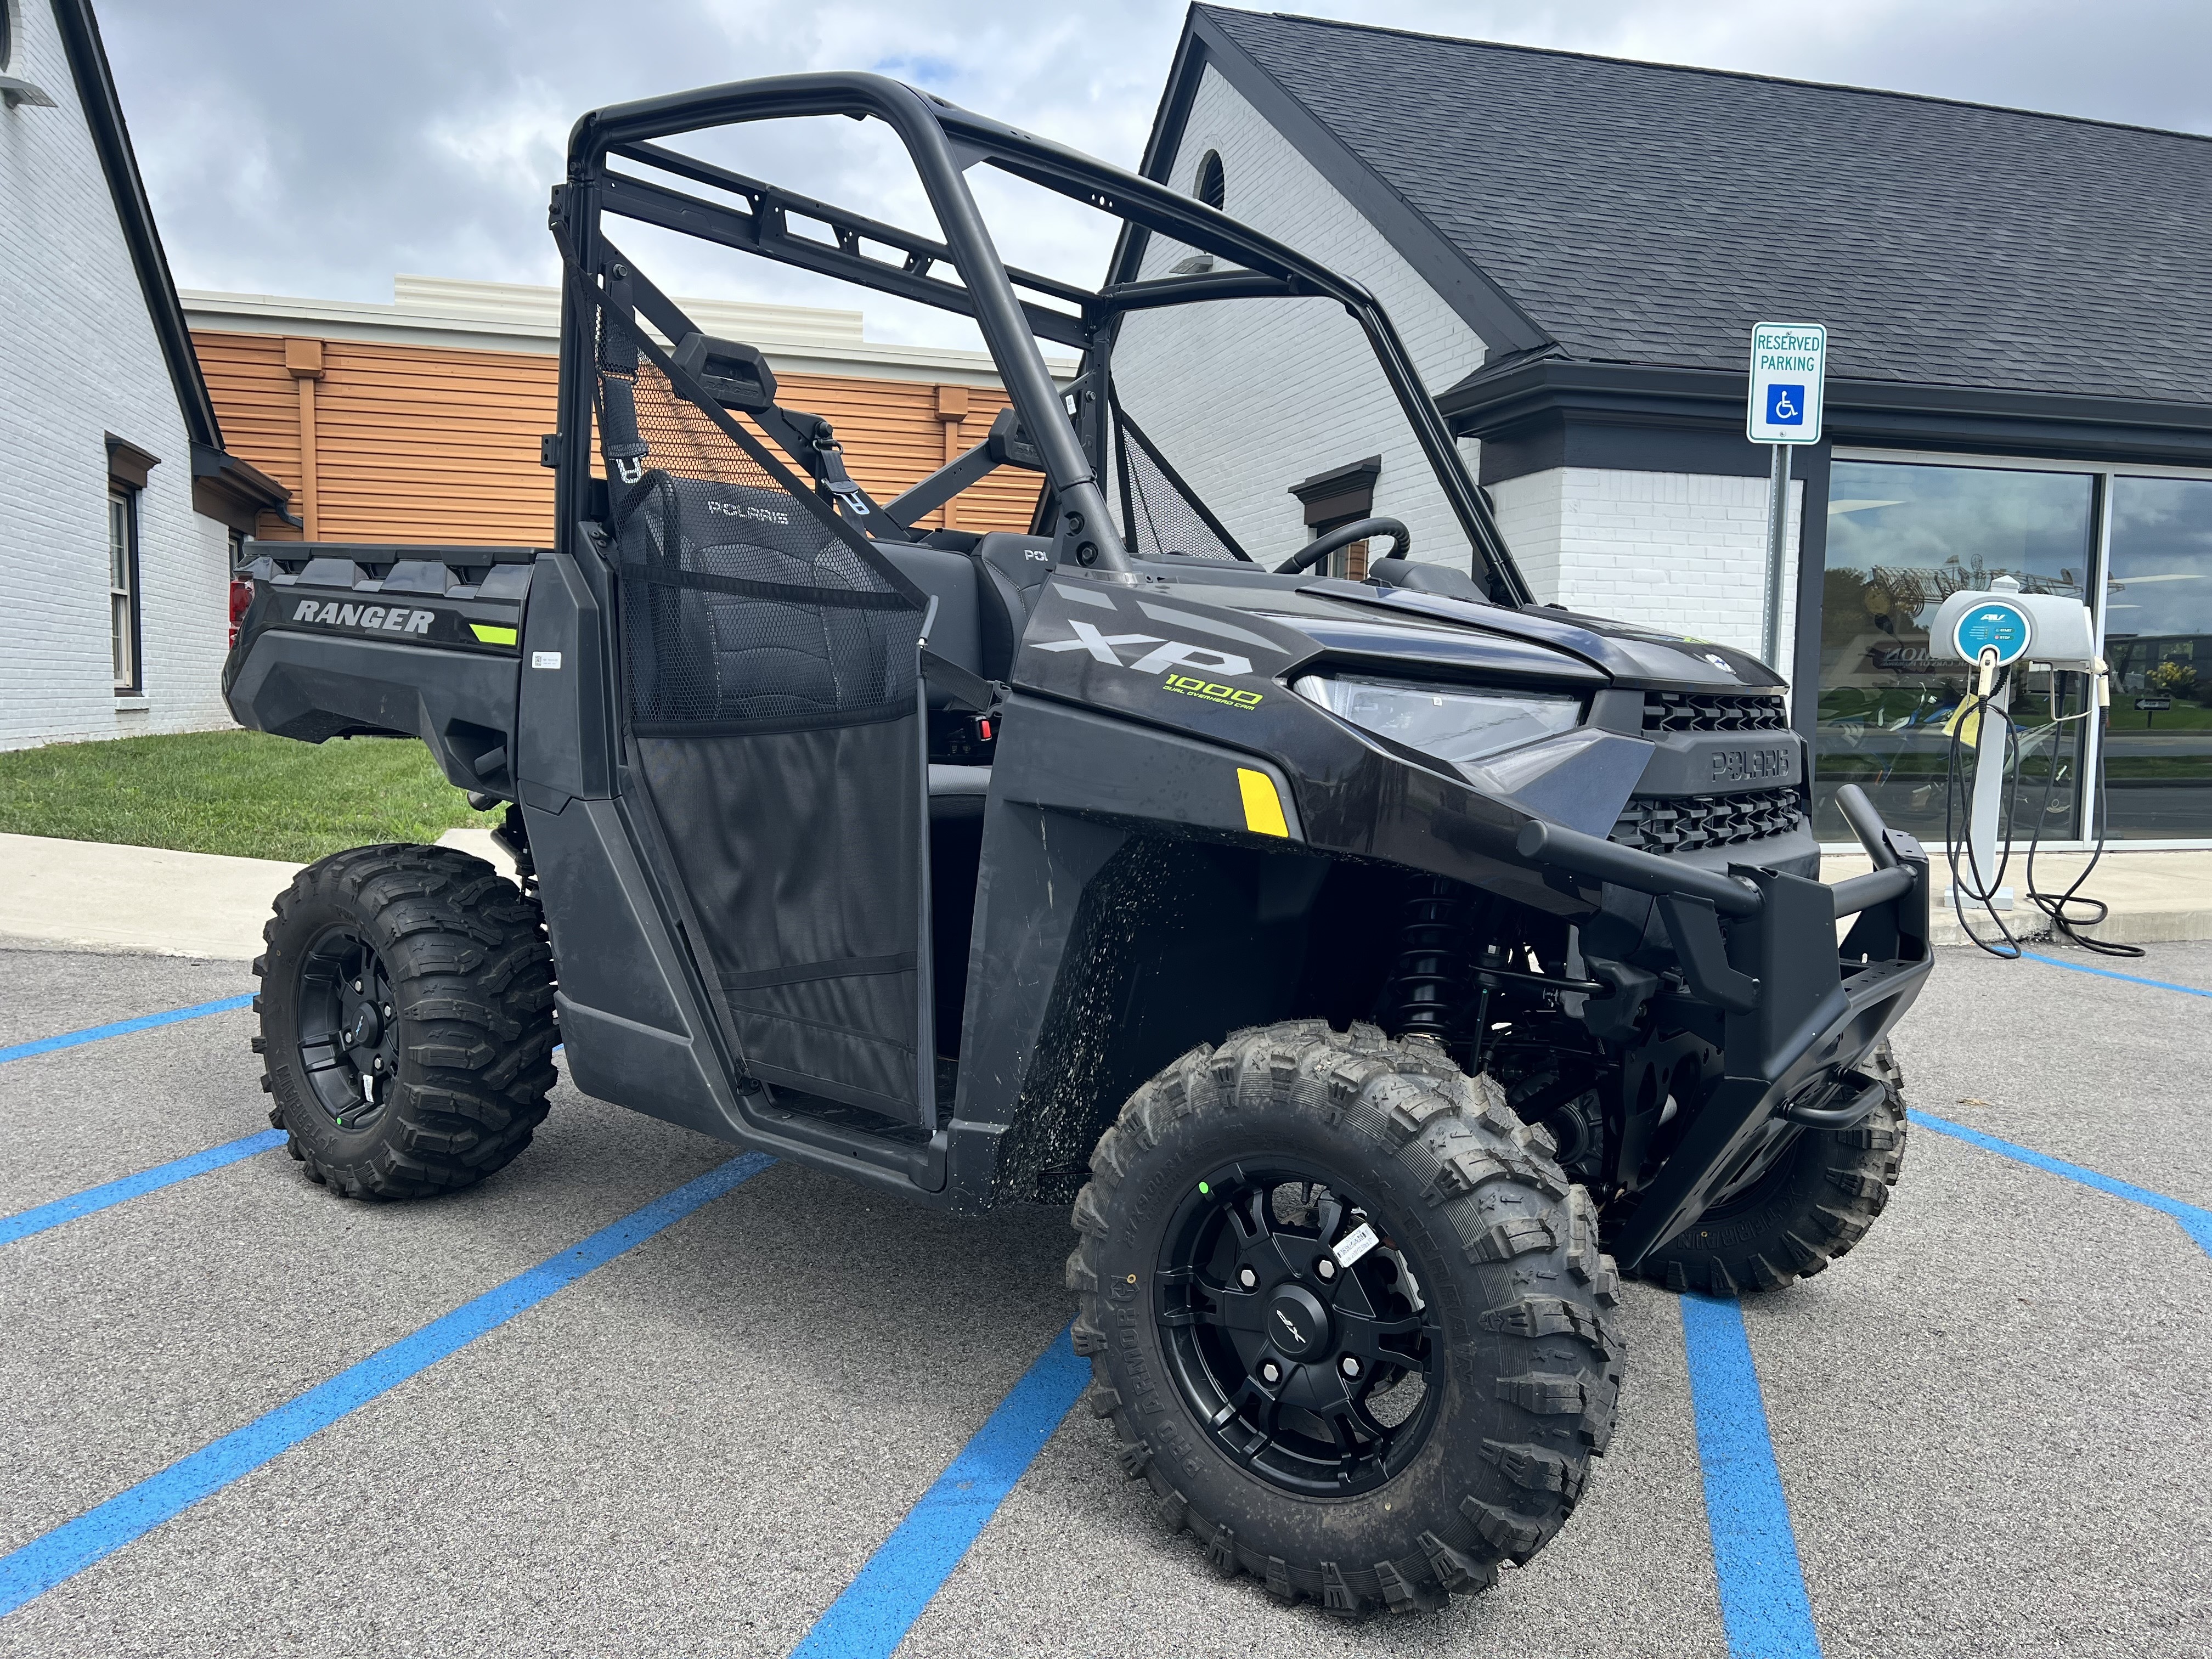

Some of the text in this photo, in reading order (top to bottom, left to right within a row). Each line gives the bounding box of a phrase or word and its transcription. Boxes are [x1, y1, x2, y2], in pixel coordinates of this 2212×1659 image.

[1758, 335, 1820, 351] RESERVED
[1761, 356, 1814, 371] PARKING
[292, 600, 435, 634] RANGER
[1029, 619, 1253, 676] XP
[1162, 685, 1255, 711] DUAL OVERHEAD CAM
[1165, 674, 1263, 705] 1000
[1711, 749, 1789, 782] POLARIS
[1276, 1310, 1306, 1344] XP
[1116, 1308, 1205, 1479] PRO ARMOR
